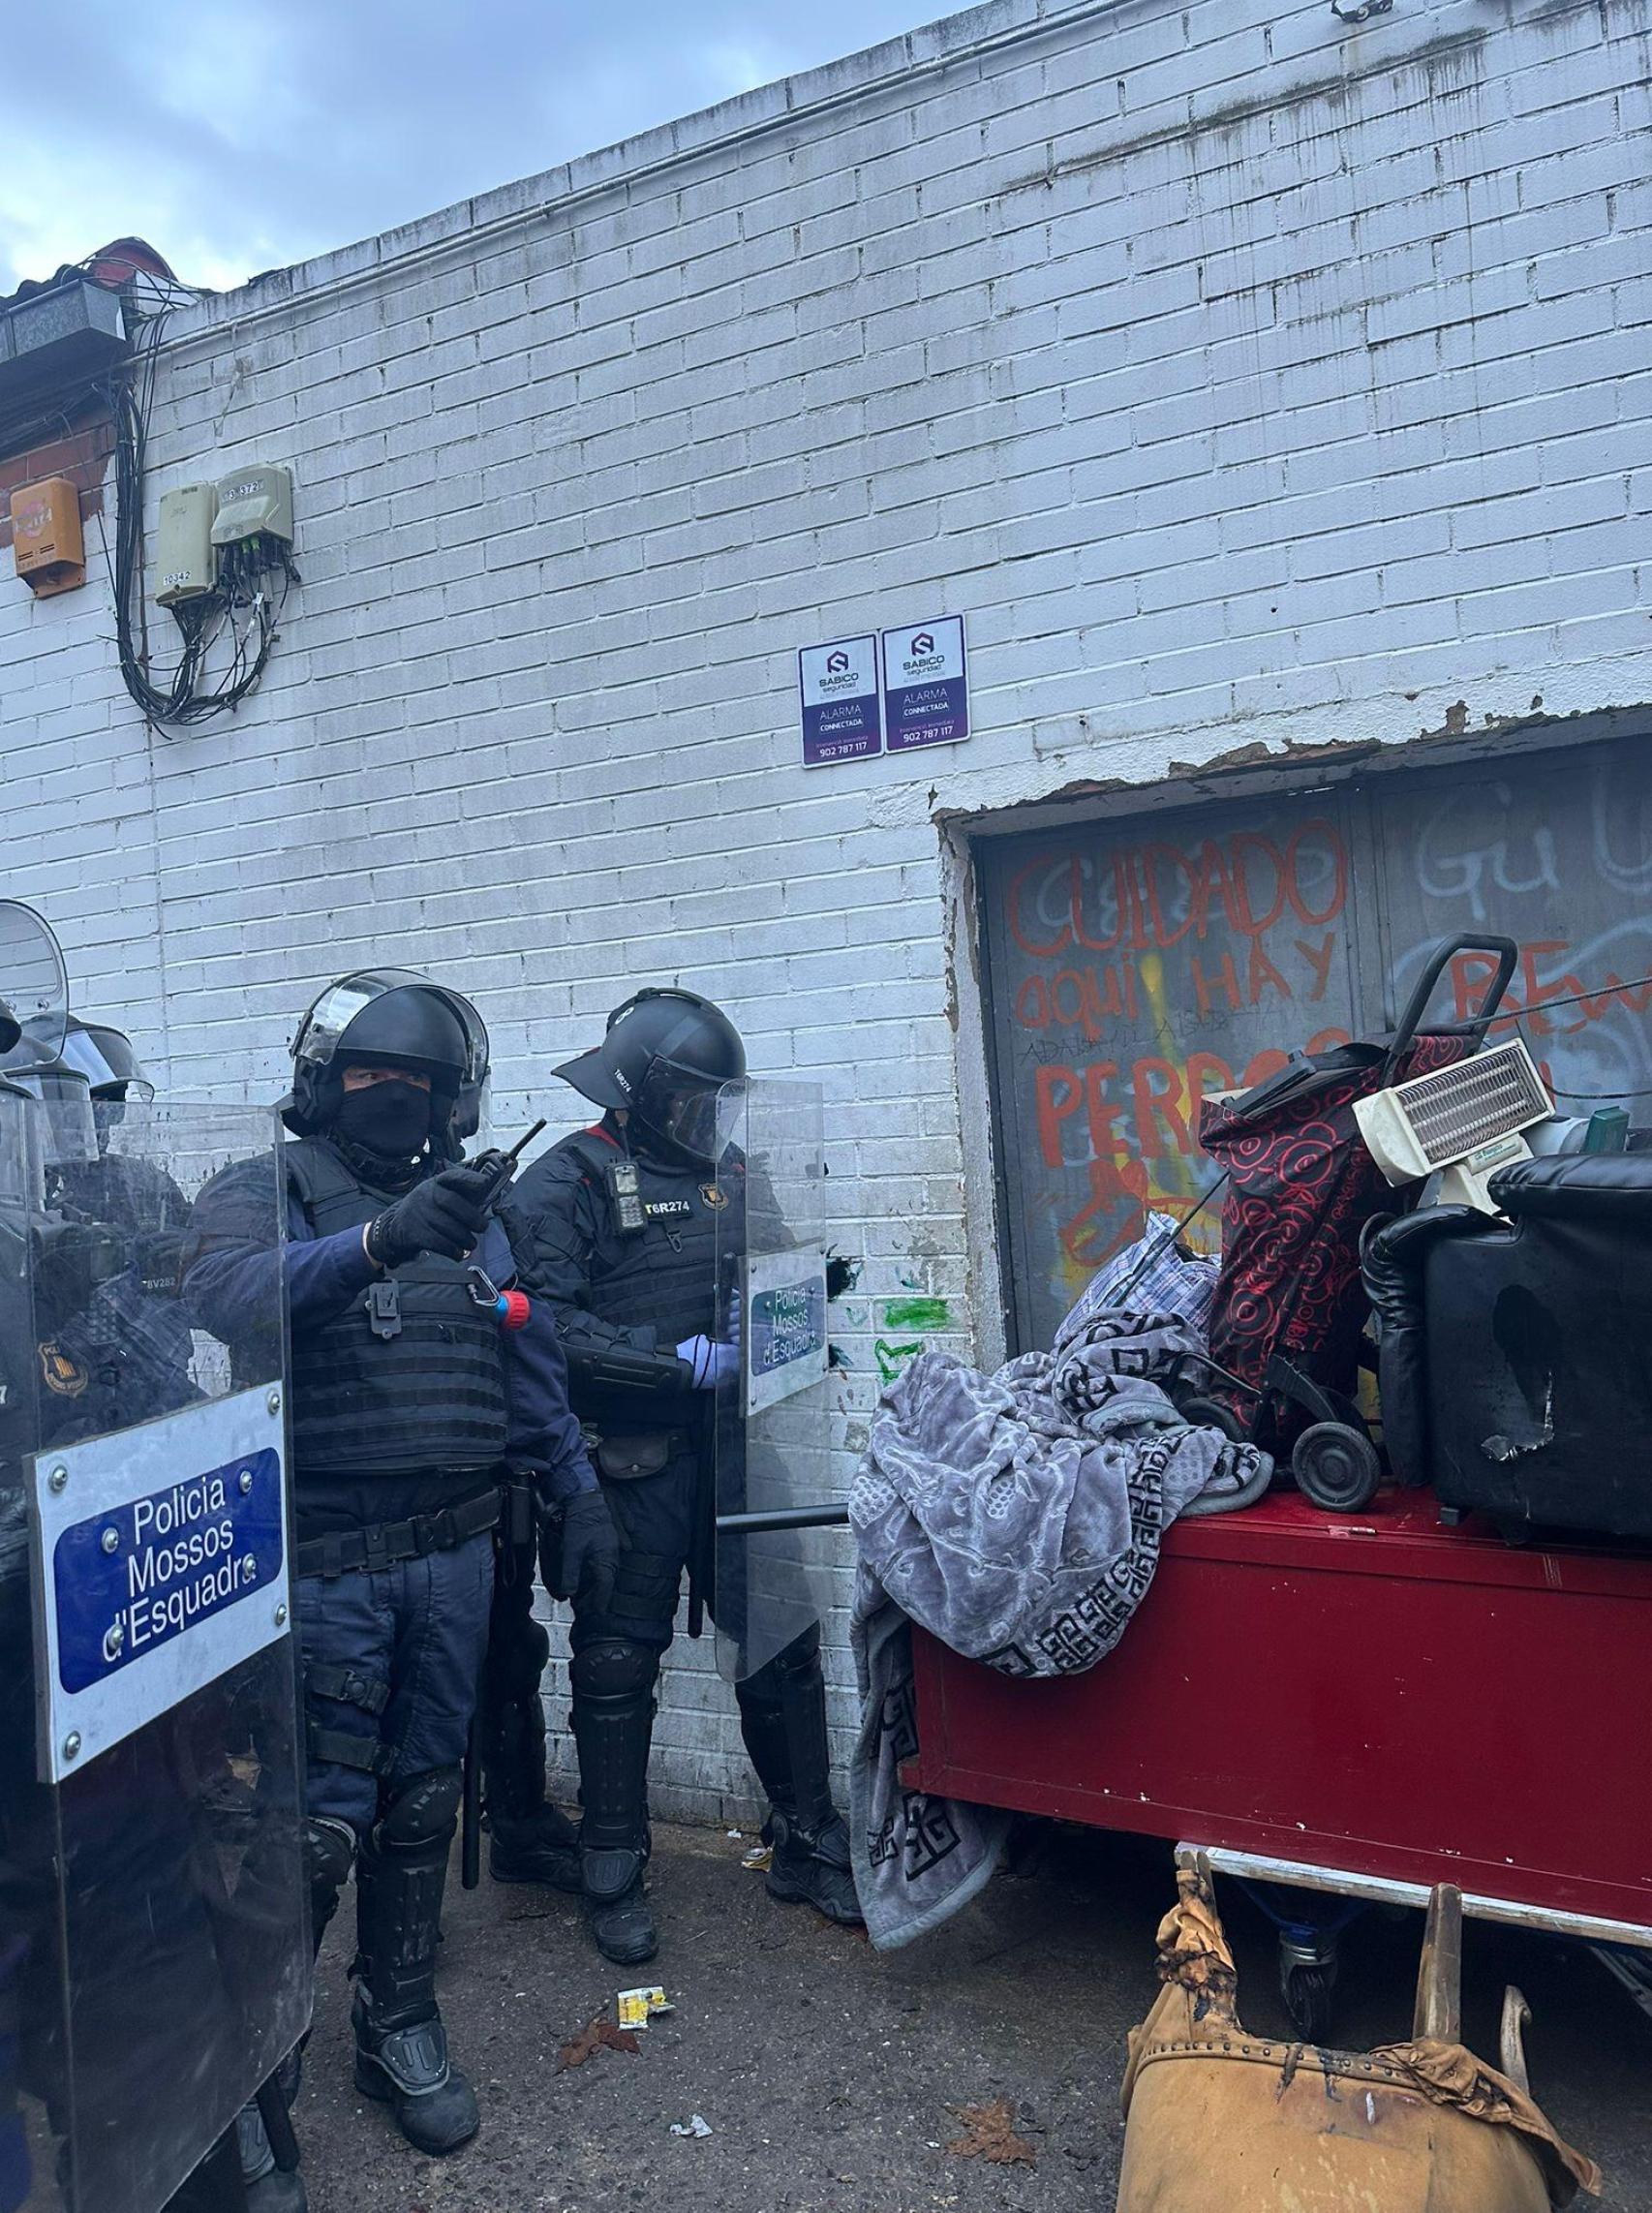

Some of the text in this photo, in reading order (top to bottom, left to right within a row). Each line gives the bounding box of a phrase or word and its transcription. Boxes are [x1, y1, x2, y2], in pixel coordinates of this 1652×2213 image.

[163, 570, 191, 585] 10342
[902, 655, 945, 670] SABICO
[906, 664, 941, 676] seguridad
[819, 672, 859, 687] SABICO
[822, 682, 857, 692] seguridad
[903, 687, 948, 705] ALARMA
[820, 704, 862, 721] ALARMA
[903, 701, 949, 717] CONNECTADA
[820, 718, 864, 732] CONNECTADA
[902, 731, 921, 743] 902
[922, 727, 938, 739] 787
[940, 724, 953, 736] 117
[819, 747, 837, 757] 902
[838, 743, 853, 754] 787
[855, 741, 868, 752] 117
[1009, 816, 1348, 958] CUIDADO
[1191, 931, 1335, 1022] HAY
[1035, 1027, 1353, 1169] PERR
[645, 1201, 689, 1214] T6R274
[773, 1308, 809, 1337] Mossos
[134, 1476, 226, 1546] Policia
[128, 1520, 233, 1599] Mossos
